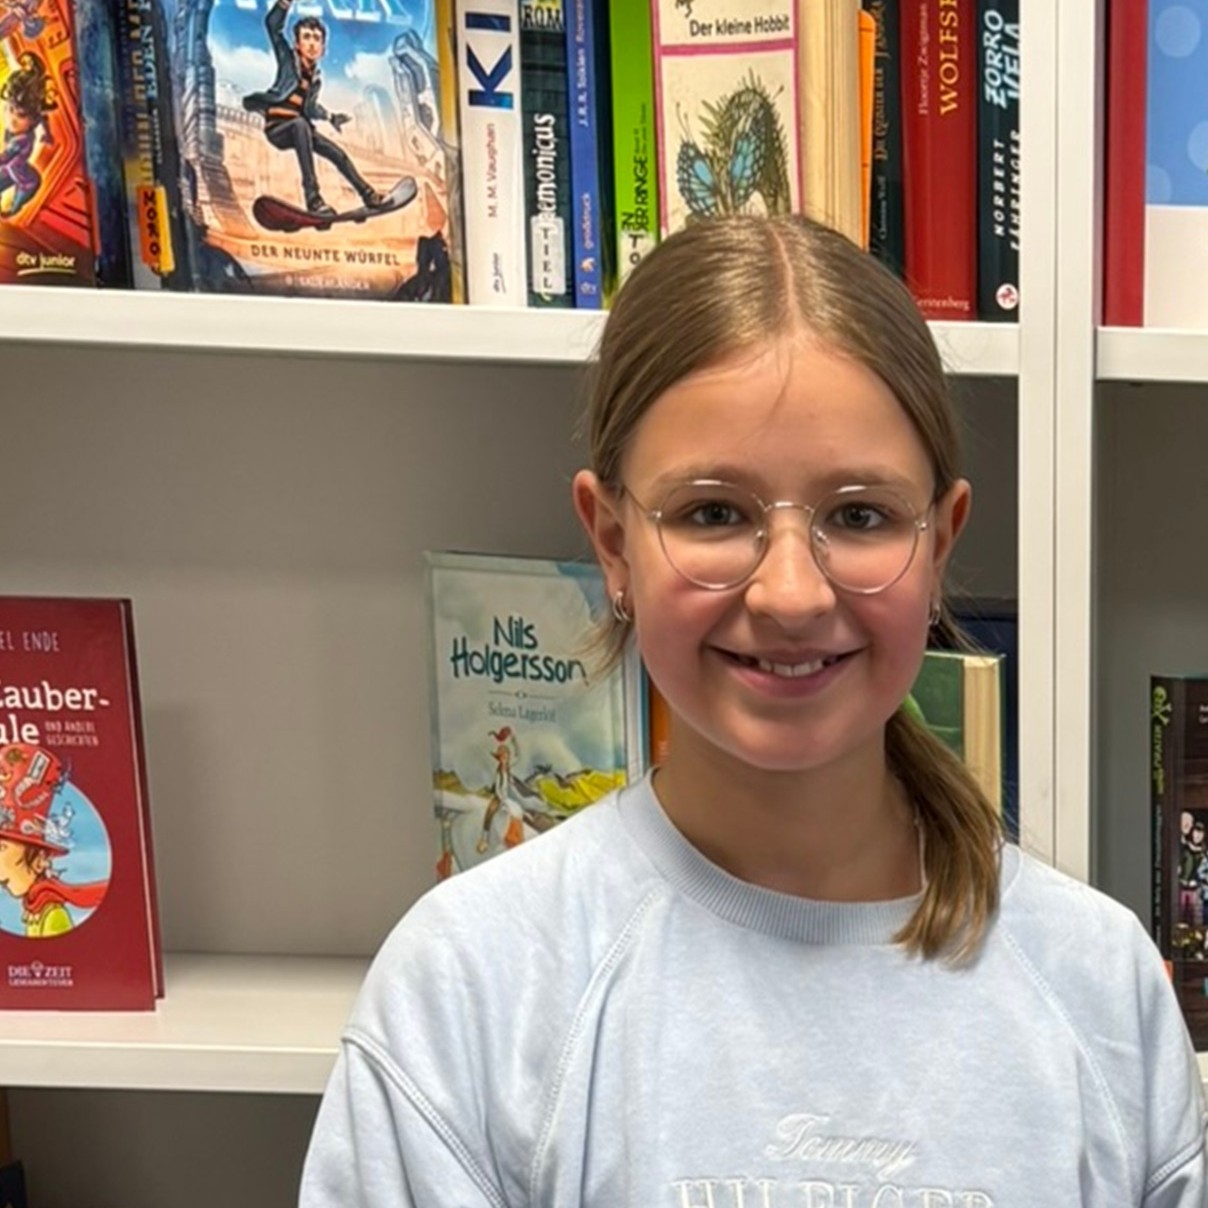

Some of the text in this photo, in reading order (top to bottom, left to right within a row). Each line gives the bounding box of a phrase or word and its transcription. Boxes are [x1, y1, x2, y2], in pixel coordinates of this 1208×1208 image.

[690, 13, 790, 38] Der kleine Hobbit
[984, 9, 1007, 110] ZORRO
[484, 124, 500, 218] M. M. Vaughan
[993, 139, 1006, 237] NORBERT
[16, 252, 76, 270] dtv junior
[251, 244, 401, 266] DER NEUNTE WÜRFEL
[23, 630, 60, 652] ENDE
[493, 615, 539, 650] Nils
[450, 636, 590, 687] Holgersson
[0, 680, 110, 712] auber-
[488, 702, 518, 718] Selma
[763, 1113, 919, 1182] Tommy
